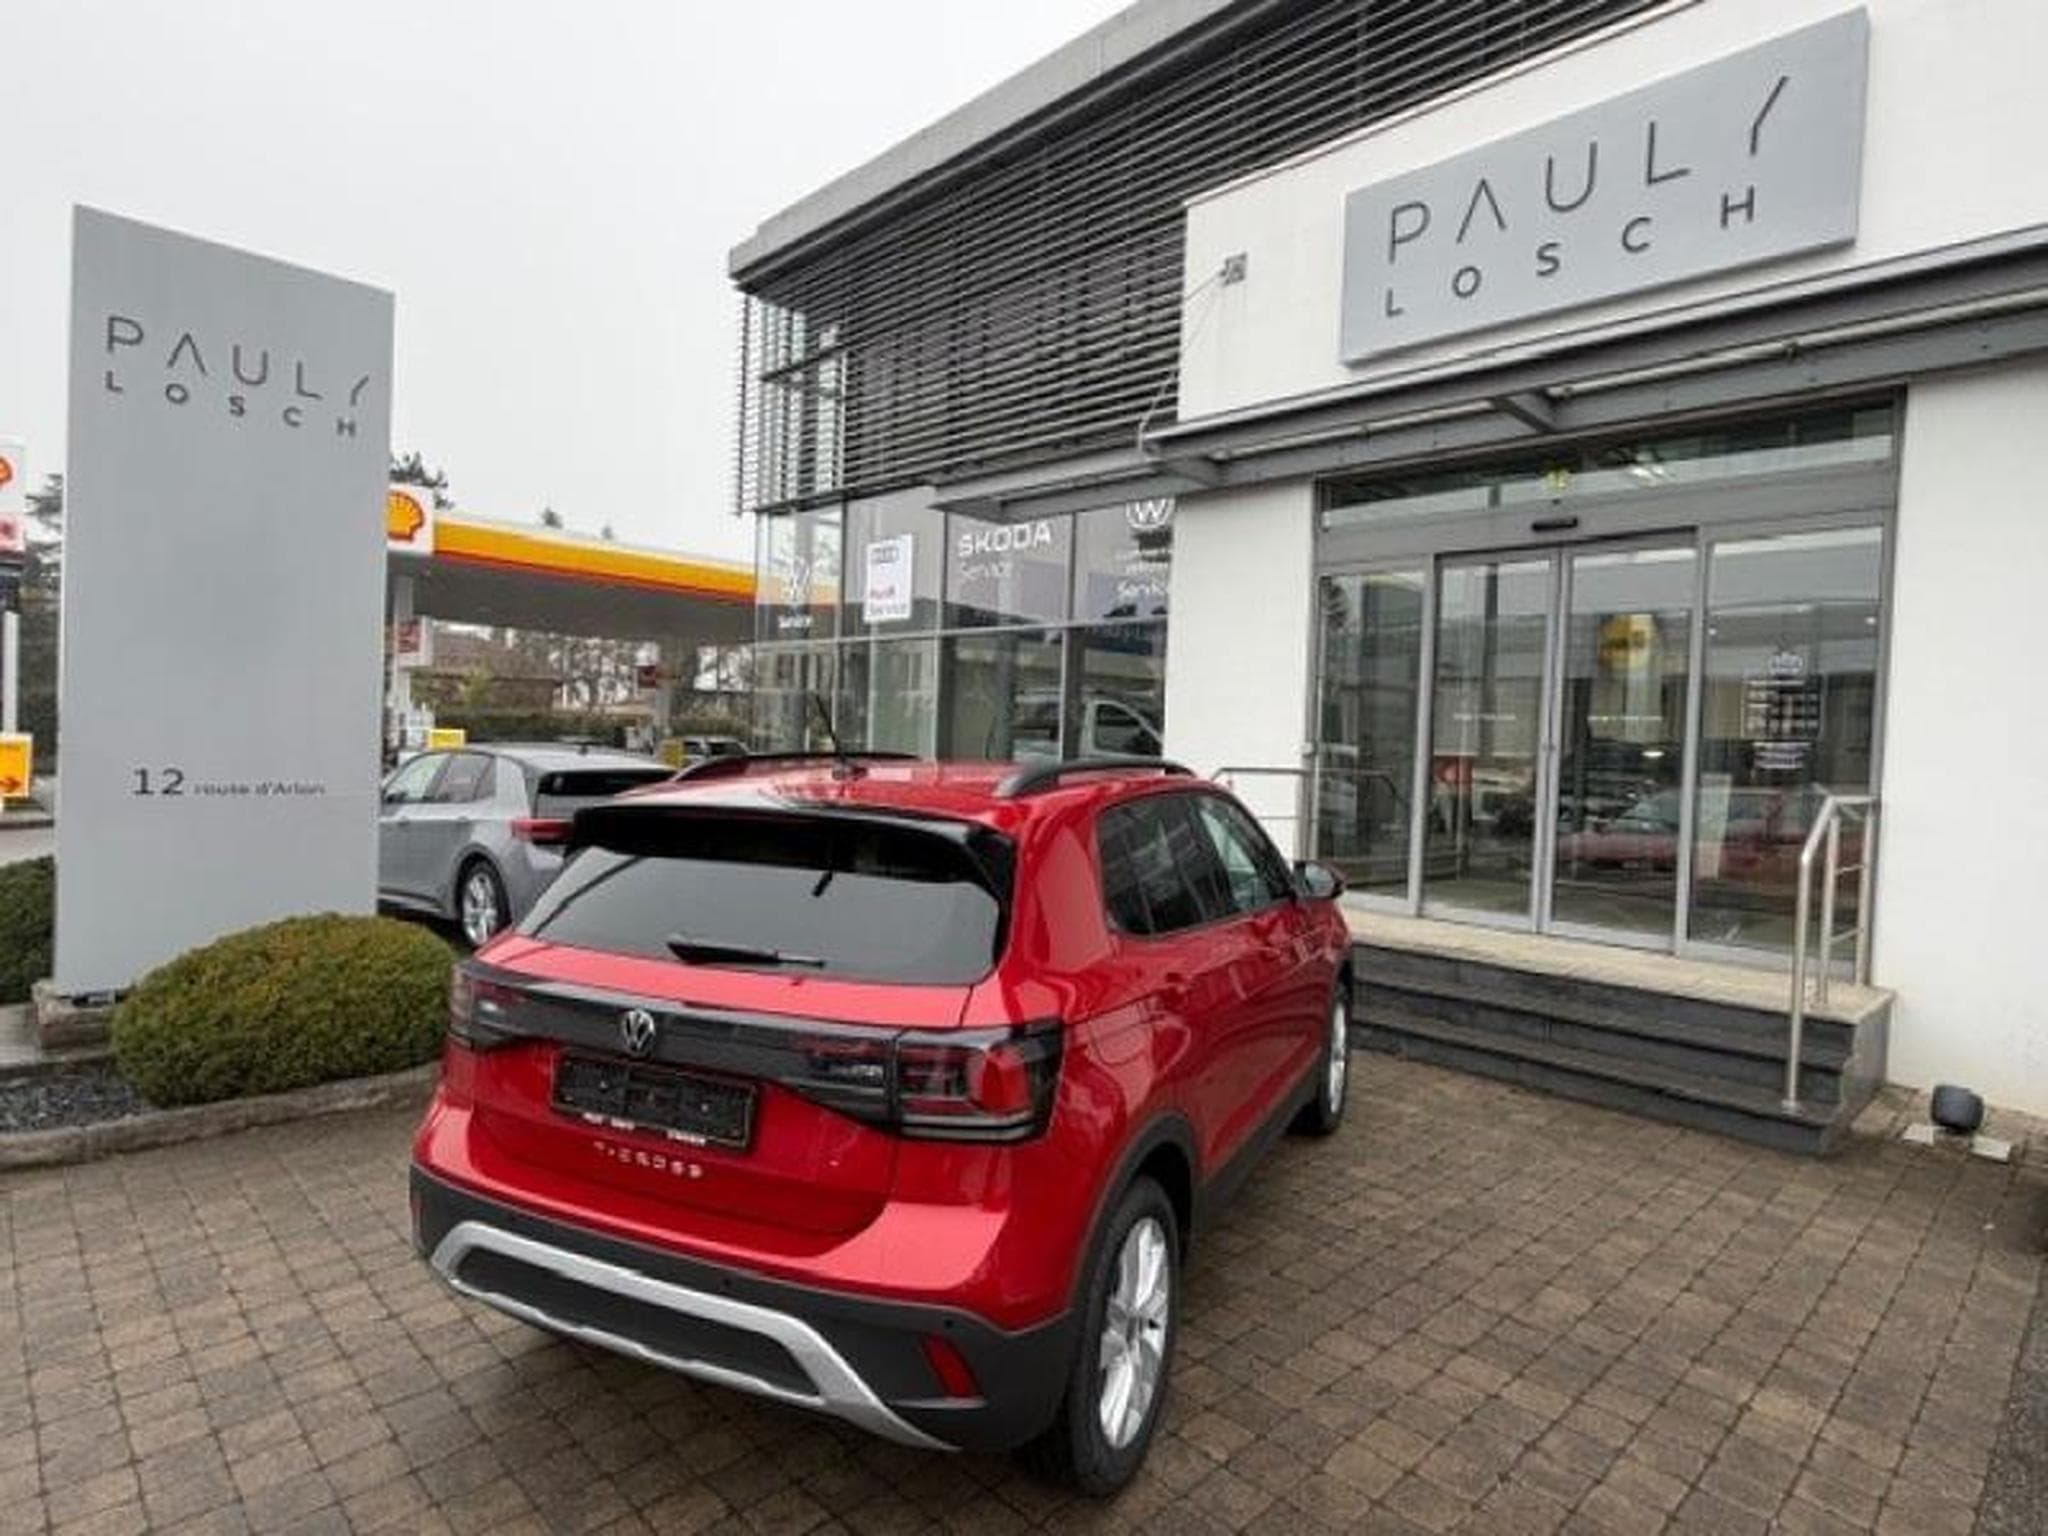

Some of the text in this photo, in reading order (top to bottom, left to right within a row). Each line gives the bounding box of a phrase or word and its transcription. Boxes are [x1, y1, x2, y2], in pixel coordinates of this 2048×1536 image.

[1388, 74, 1790, 265] PAULY
[1386, 185, 1756, 318] LOSCH
[105, 370, 357, 437] LOSCH
[106, 315, 370, 406] PAULY
[133, 767, 185, 796] 12
